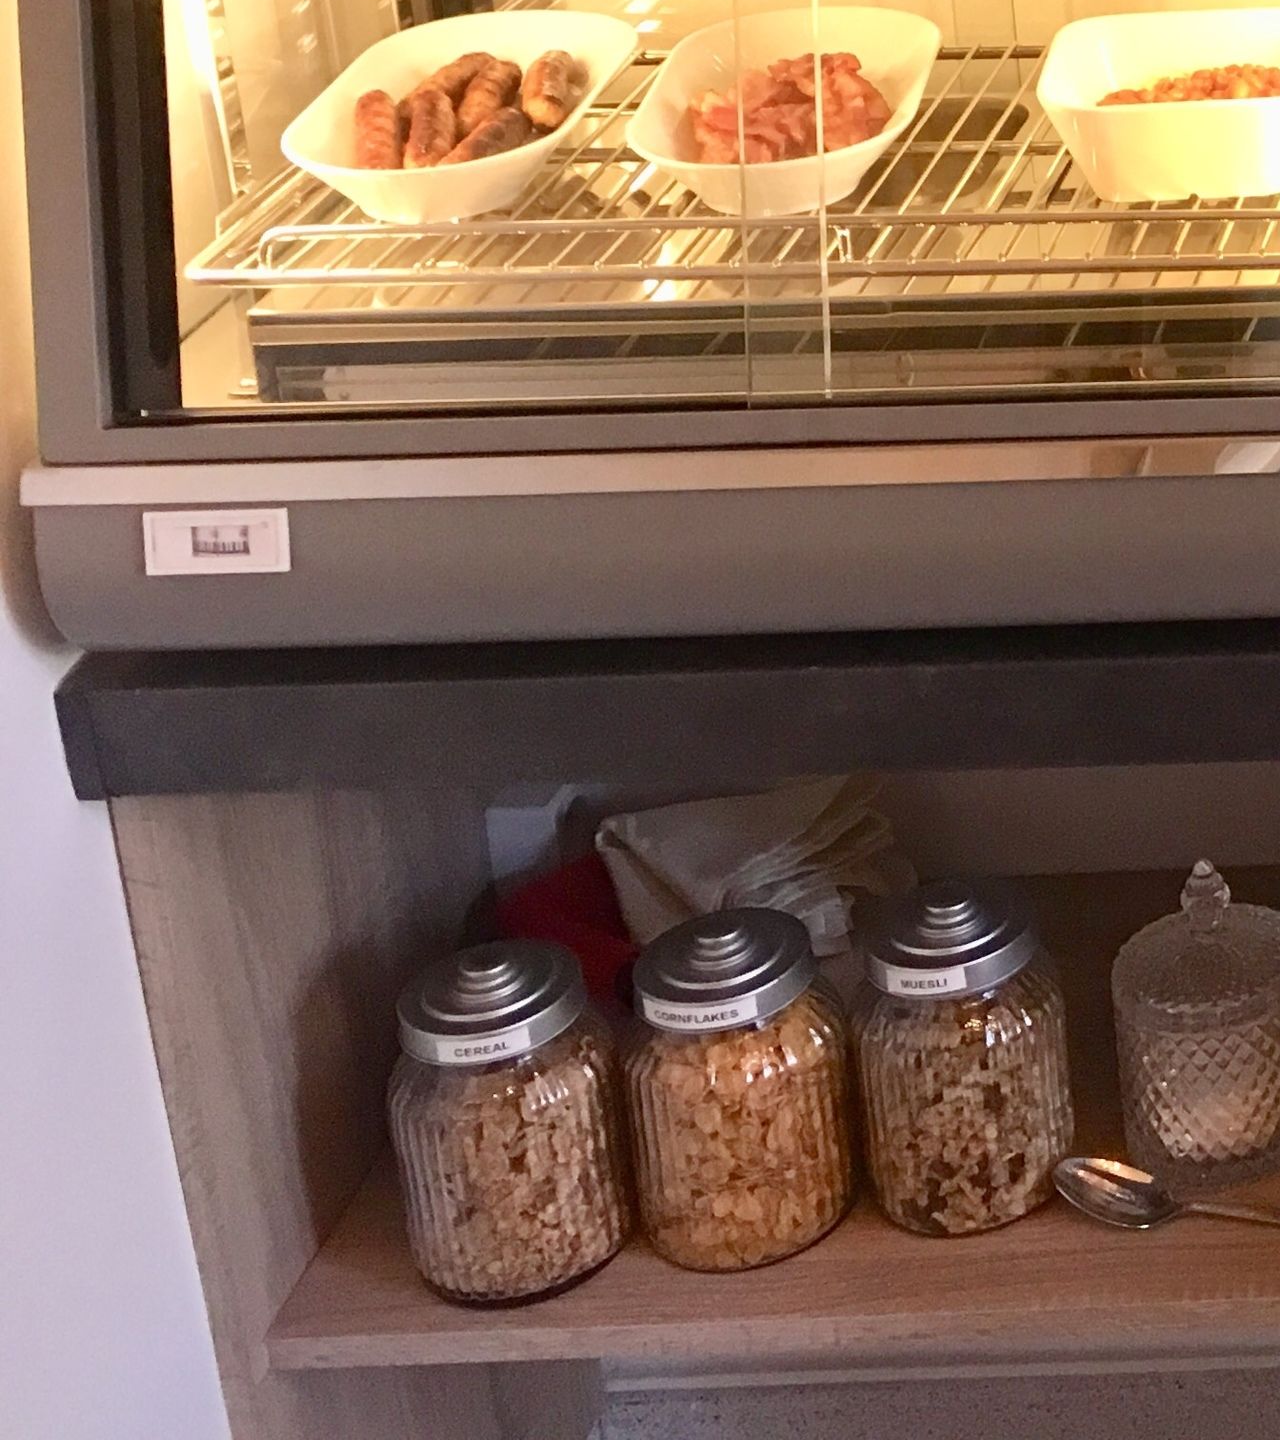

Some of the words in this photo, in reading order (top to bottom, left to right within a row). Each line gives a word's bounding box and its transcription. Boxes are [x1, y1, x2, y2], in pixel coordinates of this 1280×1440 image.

[900, 978, 948, 990] MUESLI
[653, 1009, 740, 1025] CORNFLAKES
[453, 1041, 510, 1058] CEREAL
